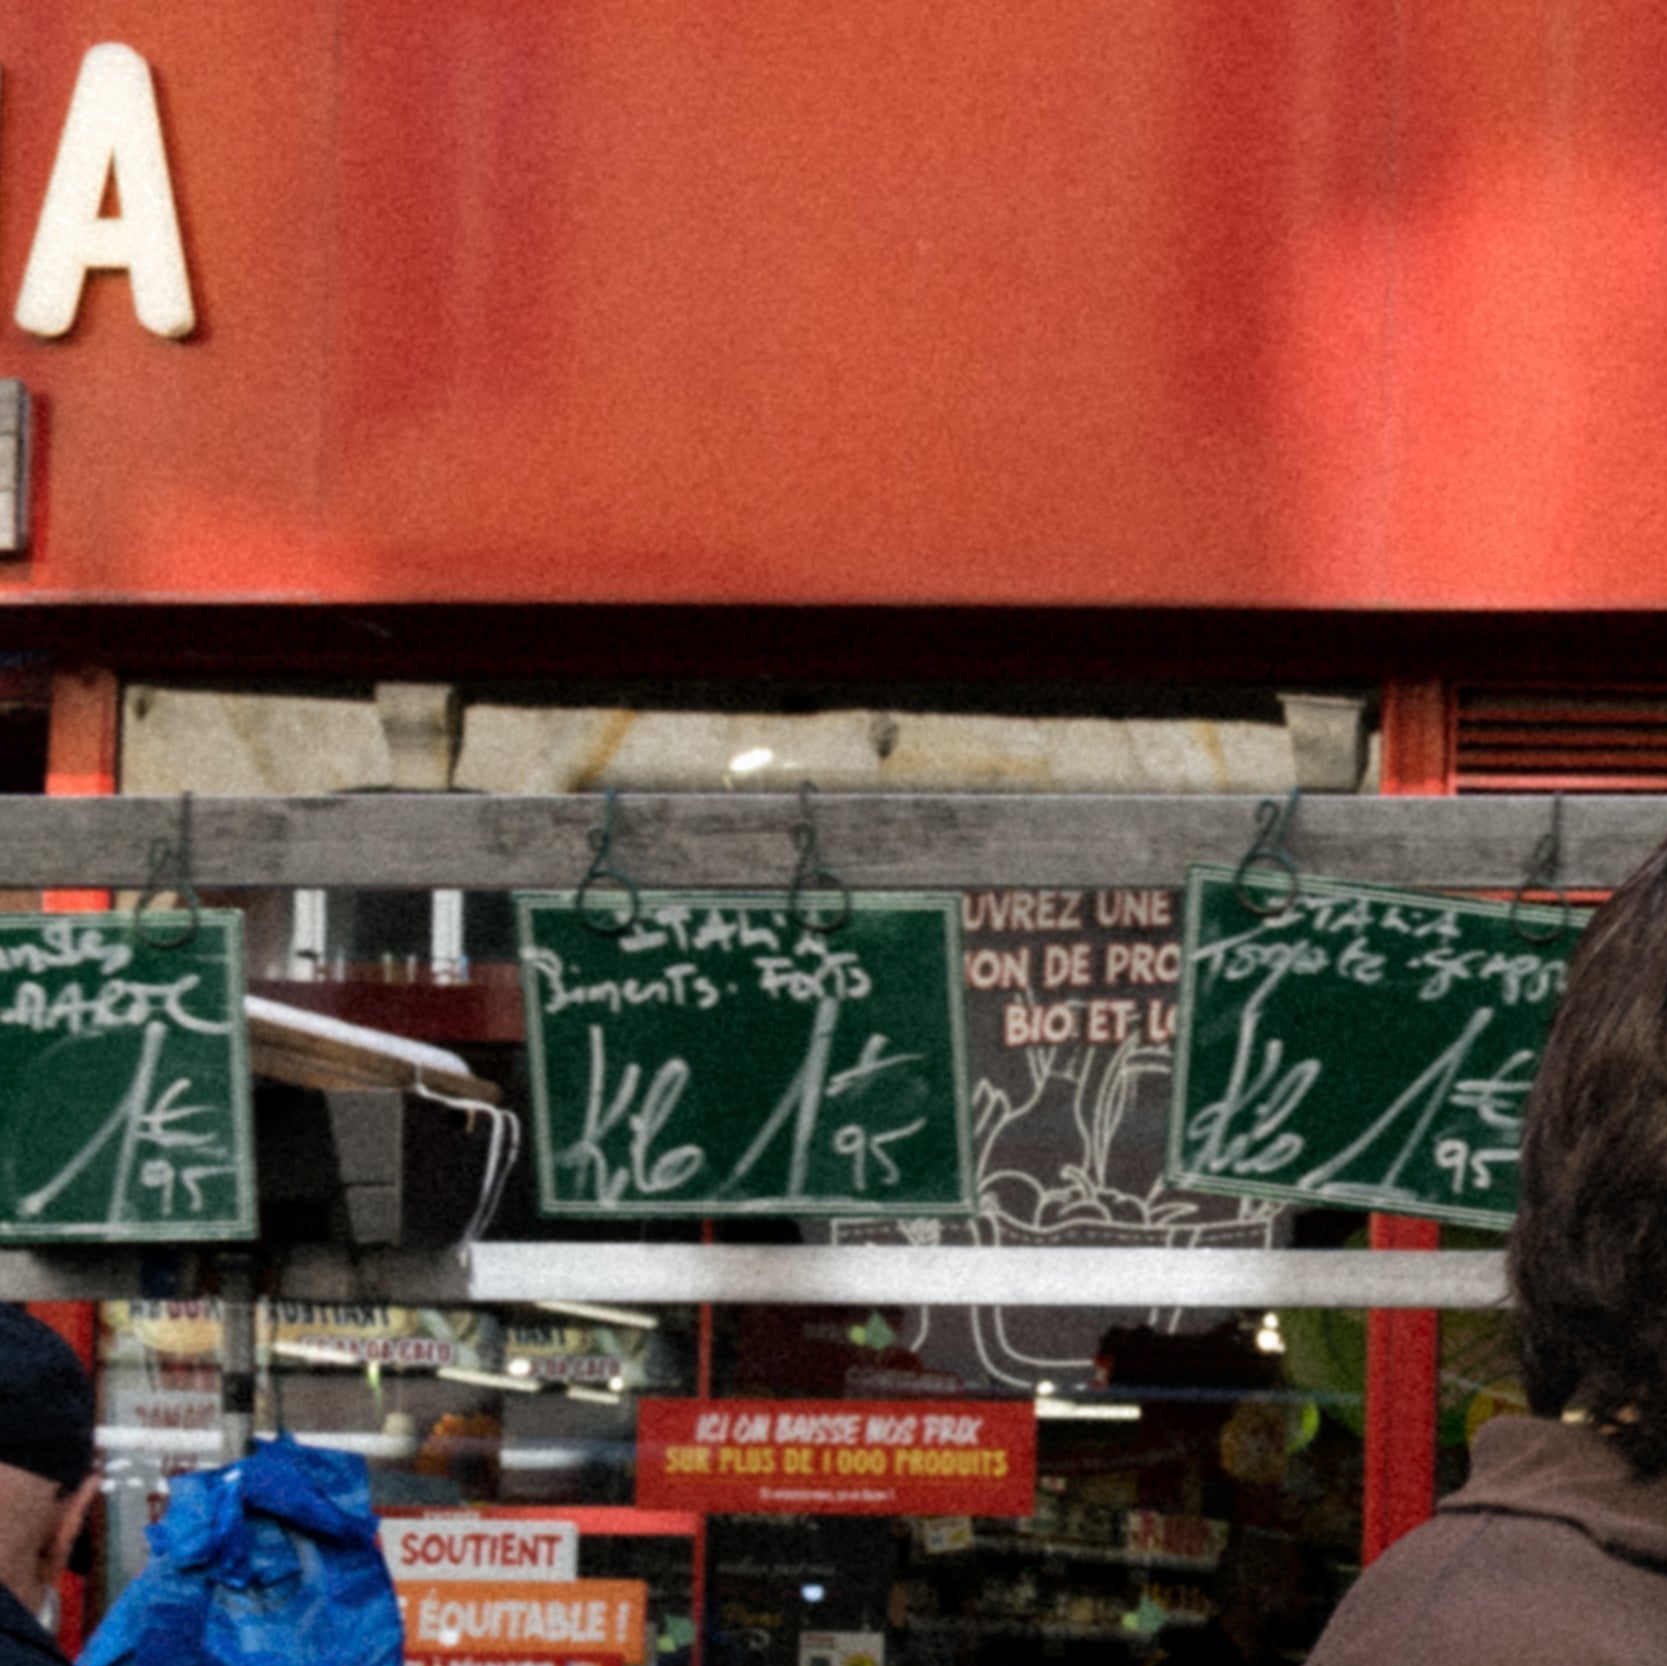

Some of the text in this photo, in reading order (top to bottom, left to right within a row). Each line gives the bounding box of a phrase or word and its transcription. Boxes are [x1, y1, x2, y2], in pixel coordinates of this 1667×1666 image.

[14, 42, 196, 337] A
[962, 891, 1172, 931] UVREZ UNE
[965, 948, 1029, 988] ON
[1043, 945, 1091, 987] DE
[1005, 1003, 1074, 1046] BIO
[1088, 1000, 1136, 1041] ET
[555, 1024, 705, 1208] Kilo
[1185, 1035, 1322, 1175] Kilo
[696, 1412, 983, 1446] ICI ON BAISSE NOS PRIX
[665, 1446, 711, 1475] SUR
[719, 1446, 776, 1475] PLUS
[783, 1447, 815, 1475] DE
[895, 1448, 1008, 1478] PRODUITS
[401, 1533, 562, 1567] SOUTIENT
[418, 1588, 607, 1643] ÉQUITABLE
